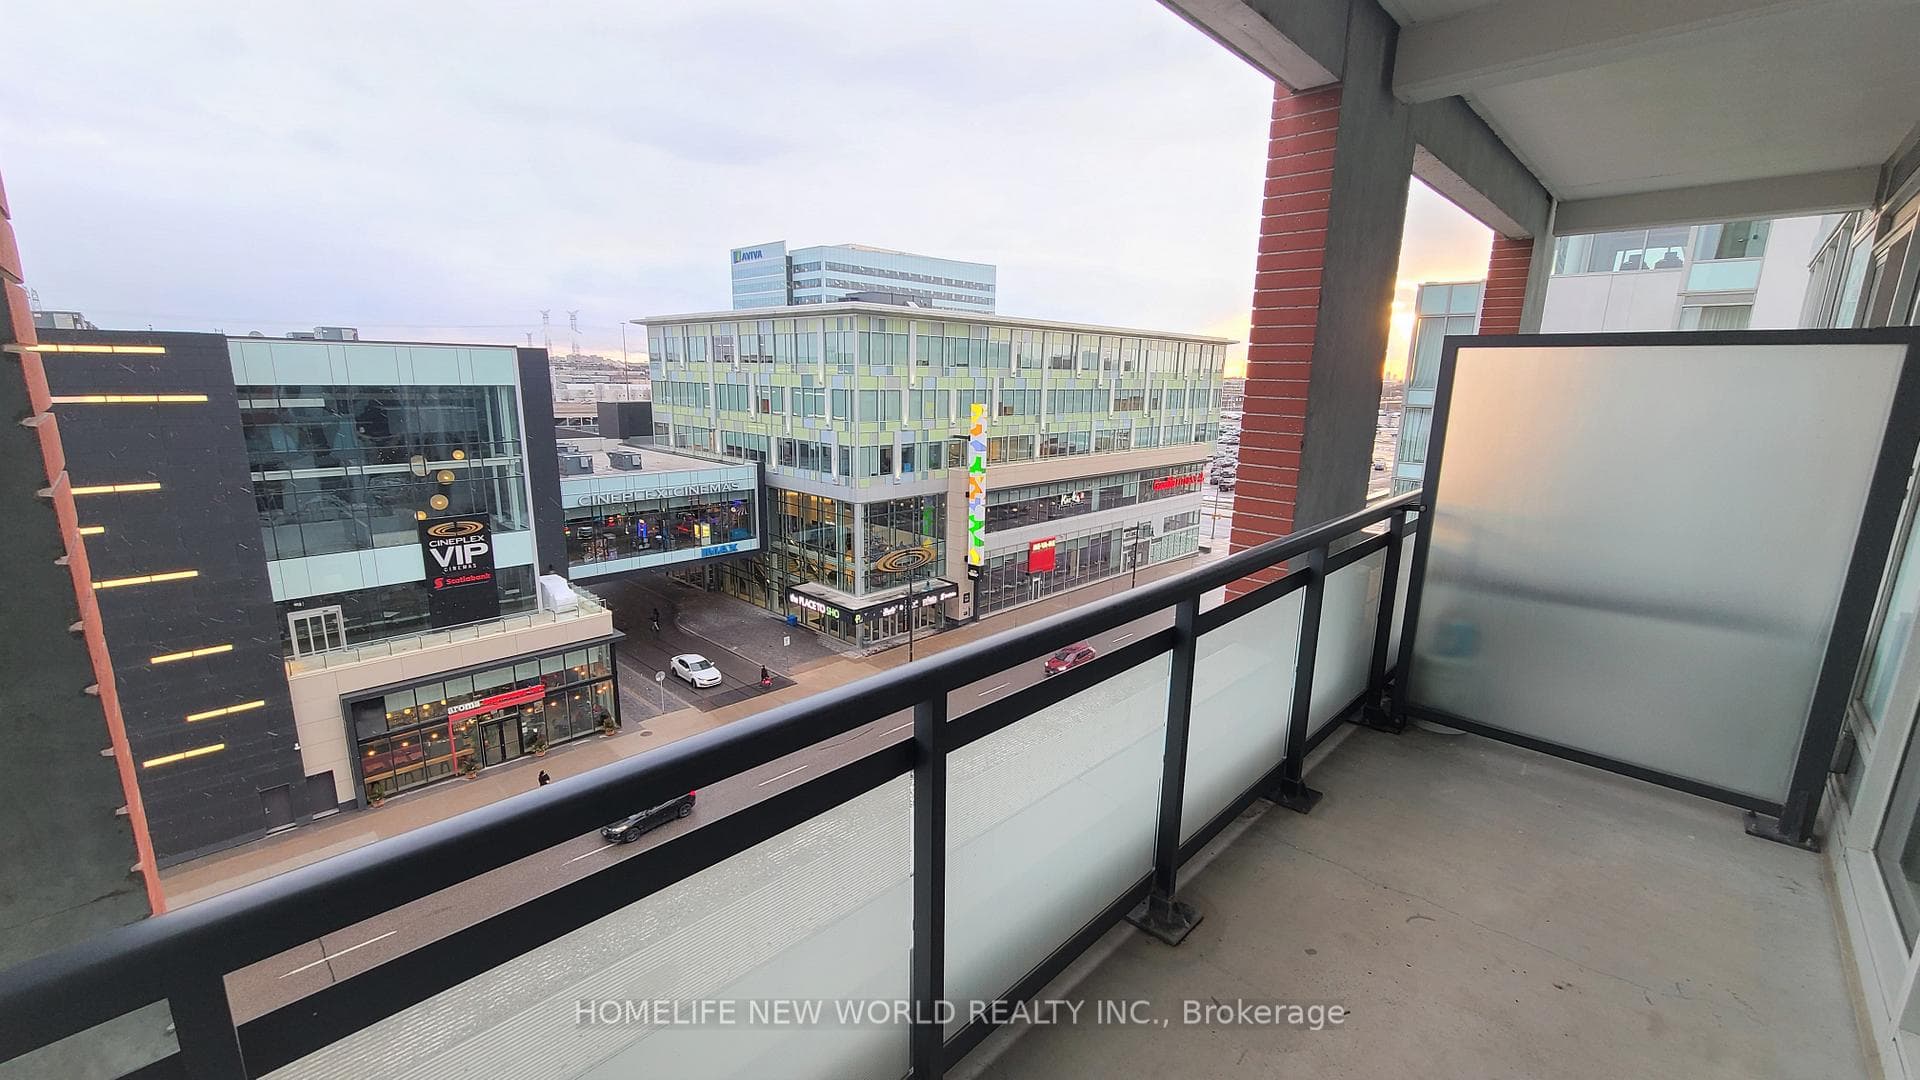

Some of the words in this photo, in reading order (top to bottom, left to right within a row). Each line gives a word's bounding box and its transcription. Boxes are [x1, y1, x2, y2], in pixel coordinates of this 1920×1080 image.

[742, 250, 763, 261] AVIVA
[578, 487, 668, 506] CINEPLEX
[672, 482, 739, 497] CINEMAS
[429, 535, 485, 547] CINEPLEX
[430, 542, 489, 568] VIP
[701, 543, 738, 558] IMAX
[444, 563, 477, 572] CINEMAS
[446, 572, 493, 584] Scotiabank
[448, 699, 481, 714] aroma
